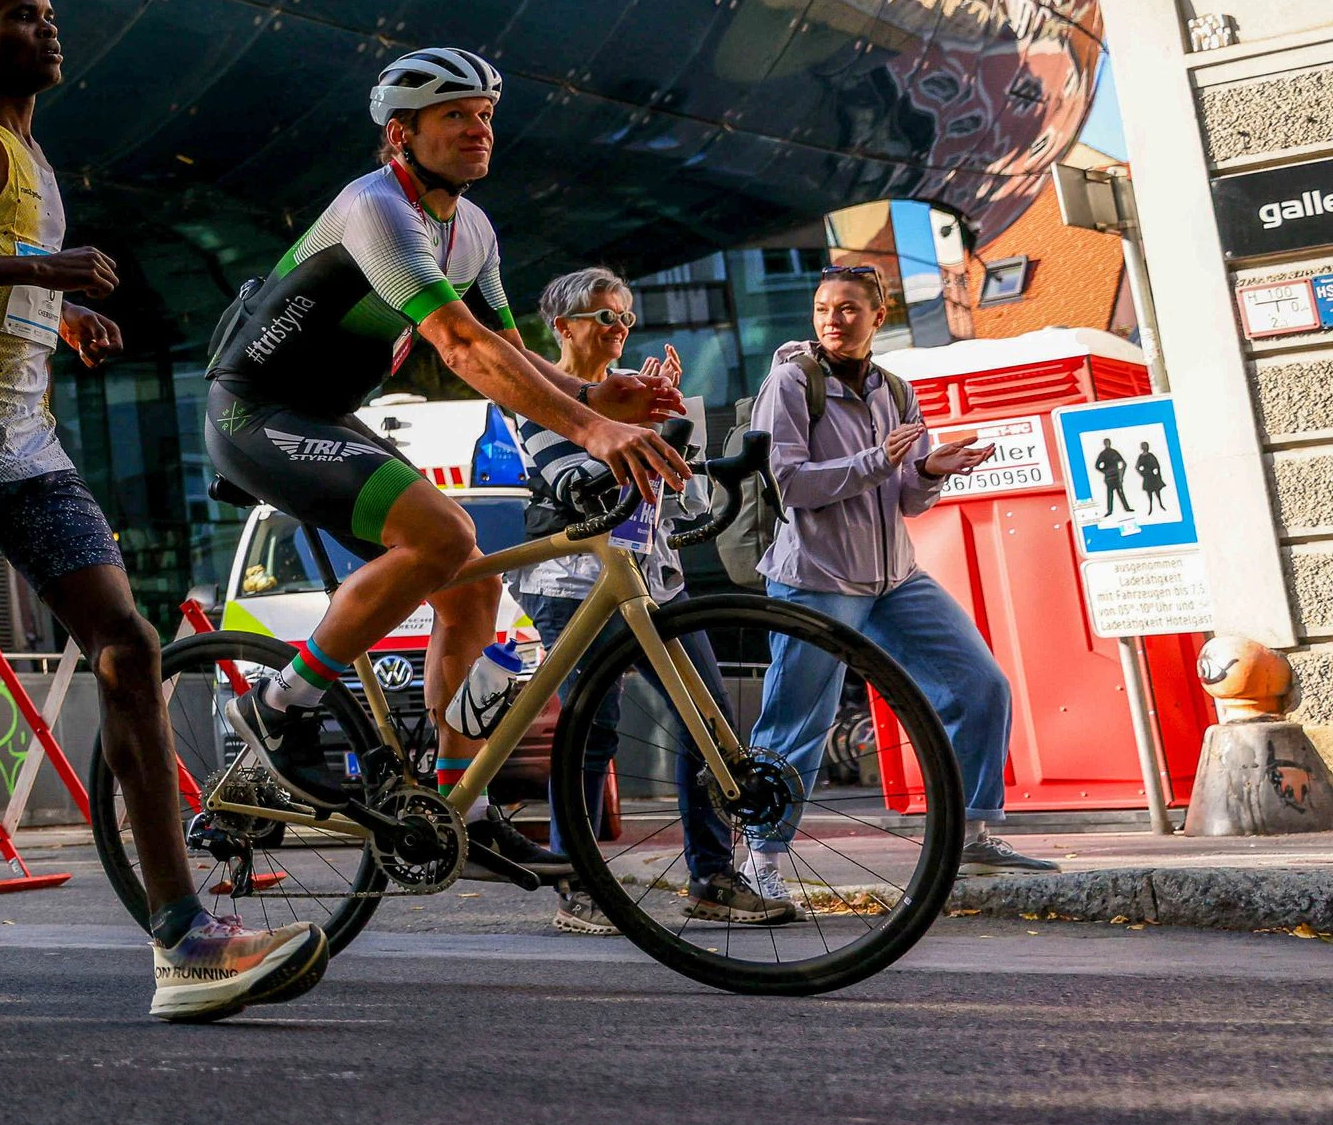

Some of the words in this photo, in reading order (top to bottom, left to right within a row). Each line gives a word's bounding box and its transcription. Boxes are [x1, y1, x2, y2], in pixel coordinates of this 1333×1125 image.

[245, 294, 316, 365] #tristyria
[302, 438, 342, 455] TRI
[289, 454, 344, 463] STYRIA
[1114, 559, 1182, 574] ausgenommen
[1098, 592, 1113, 602] mit
[1116, 588, 1171, 600] Fahrzeugen
[1174, 586, 1189, 596] bis
[1099, 607, 1115, 617] von
[1156, 601, 1173, 613] Uhr
[155, 966, 171, 980] ON
[172, 965, 239, 980] RUNNING
